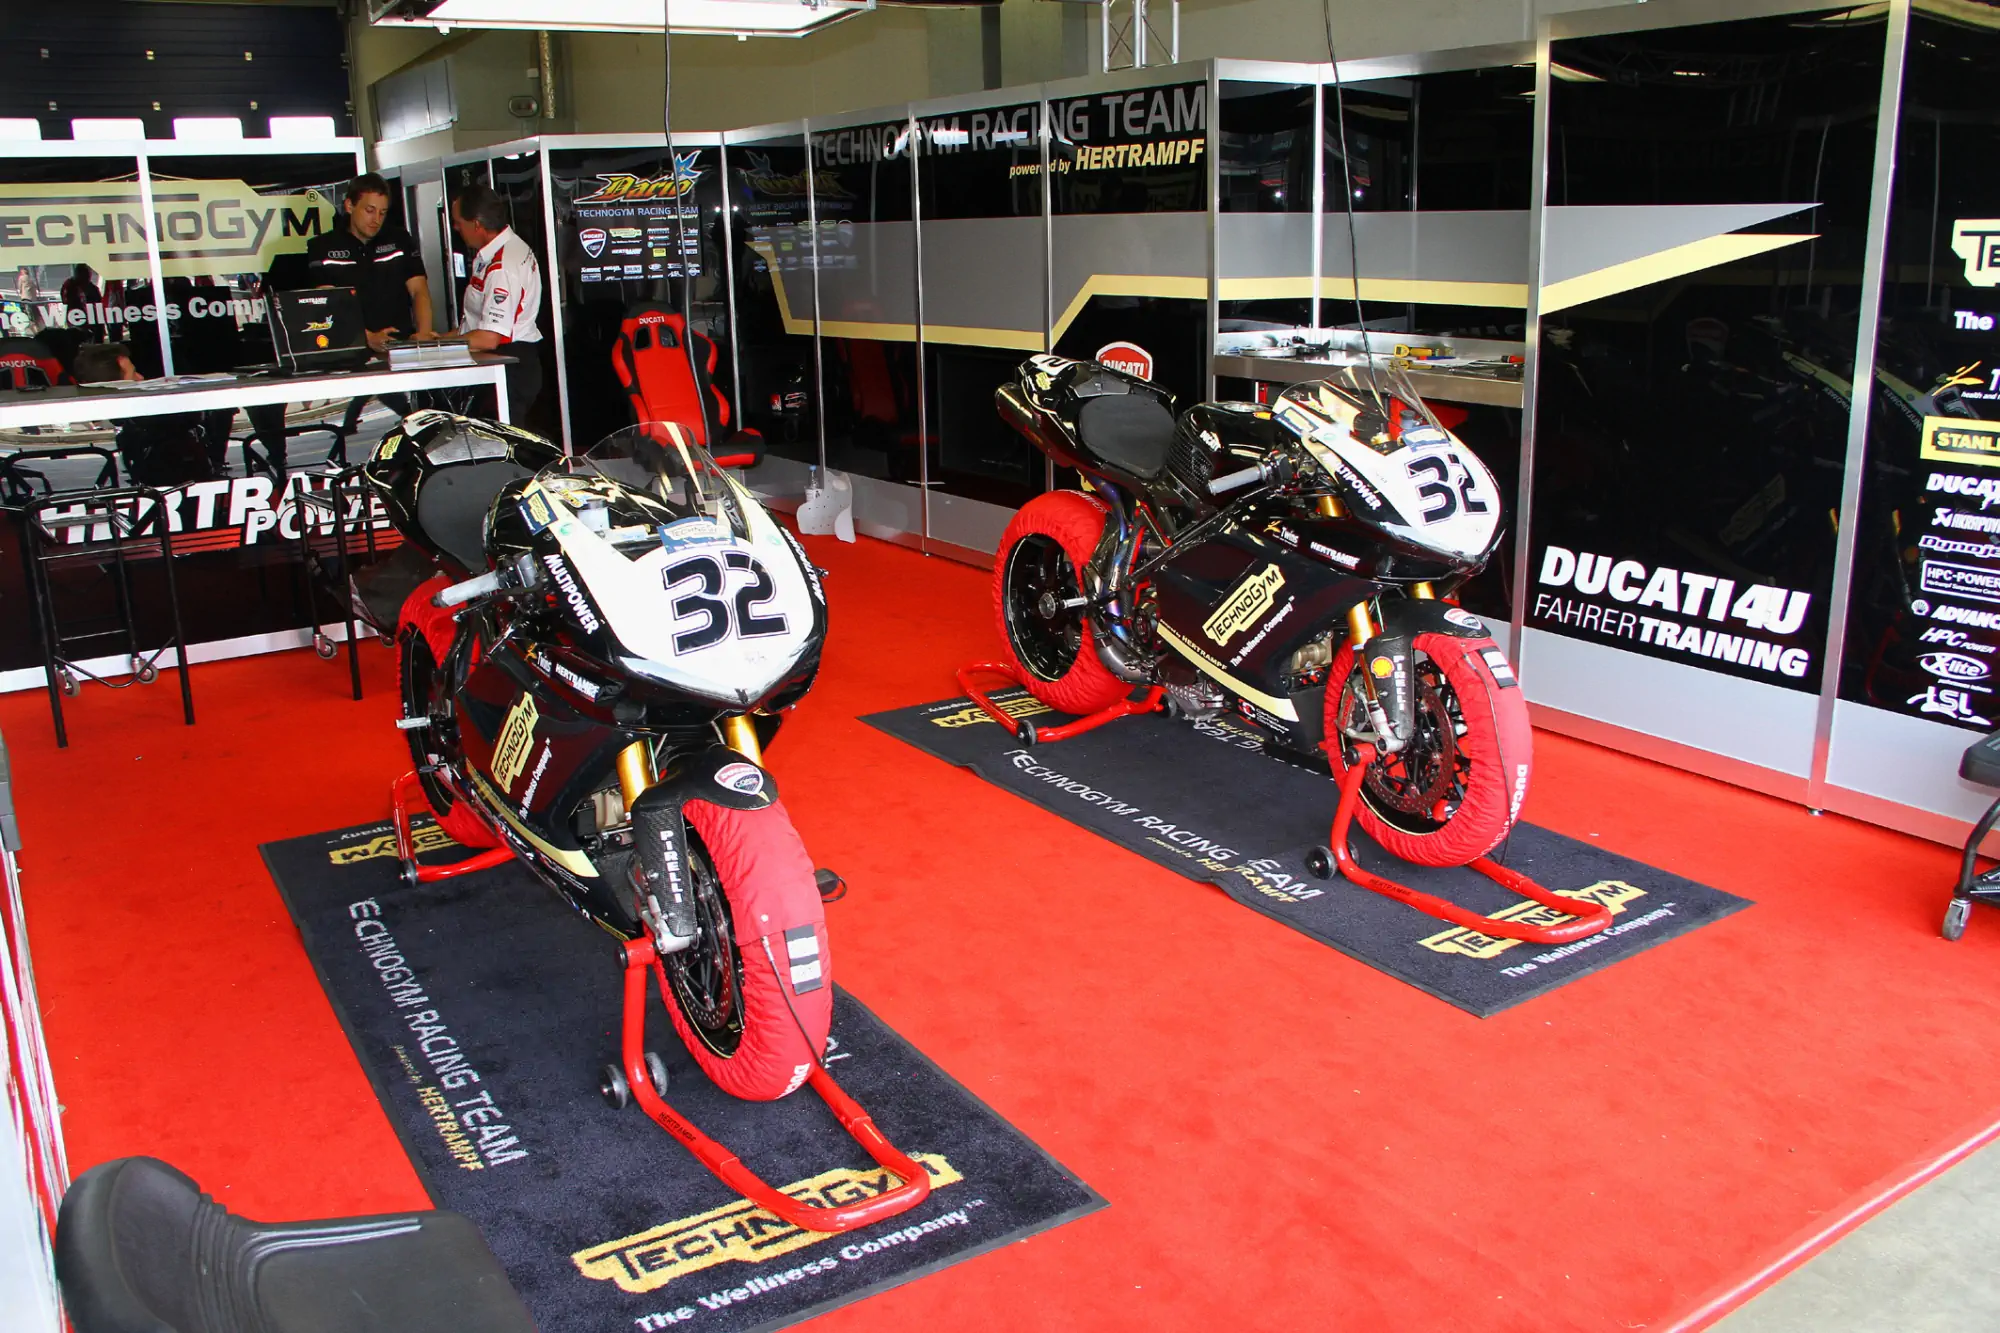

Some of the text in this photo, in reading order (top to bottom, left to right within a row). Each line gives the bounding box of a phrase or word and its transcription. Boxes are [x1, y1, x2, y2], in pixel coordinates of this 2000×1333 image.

[810, 85, 1206, 168] TECHNOGYM RACING TEAM
[1009, 139, 1204, 179] powerd by HERTRAMPF
[0, 199, 321, 262] ECHNOGYM
[578, 208, 635, 218] TECHNOGYM
[637, 206, 671, 216] RACING
[38, 302, 182, 328] Wellness
[188, 296, 266, 325] Comp
[639, 315, 665, 325] DUCATI
[1954, 310, 1994, 331] The
[1404, 453, 1491, 526] 32
[543, 553, 600, 635] MULTIPOWER
[661, 550, 790, 657] 32
[1206, 570, 1280, 641] TECHNOGYM
[1263, 601, 1294, 632] Company
[1930, 604, 2000, 631] ADVANC
[1182, 634, 1228, 671] HERTRAMPF
[1919, 627, 1968, 647] HPC
[494, 700, 535, 786] TECHNOGYM
[660, 830, 684, 904] PIRELLI
[1133, 815, 1240, 862] RACING
[1250, 858, 1324, 901] EAM
[1500, 907, 1676, 978] The Wellness Company
[349, 898, 430, 1009] ECHNOGYM
[403, 1008, 481, 1091] RACING
[456, 1089, 530, 1167] TEAM
[416, 1085, 485, 1173] HERTRAMPF
[634, 1207, 972, 1333] The Wellness Company
